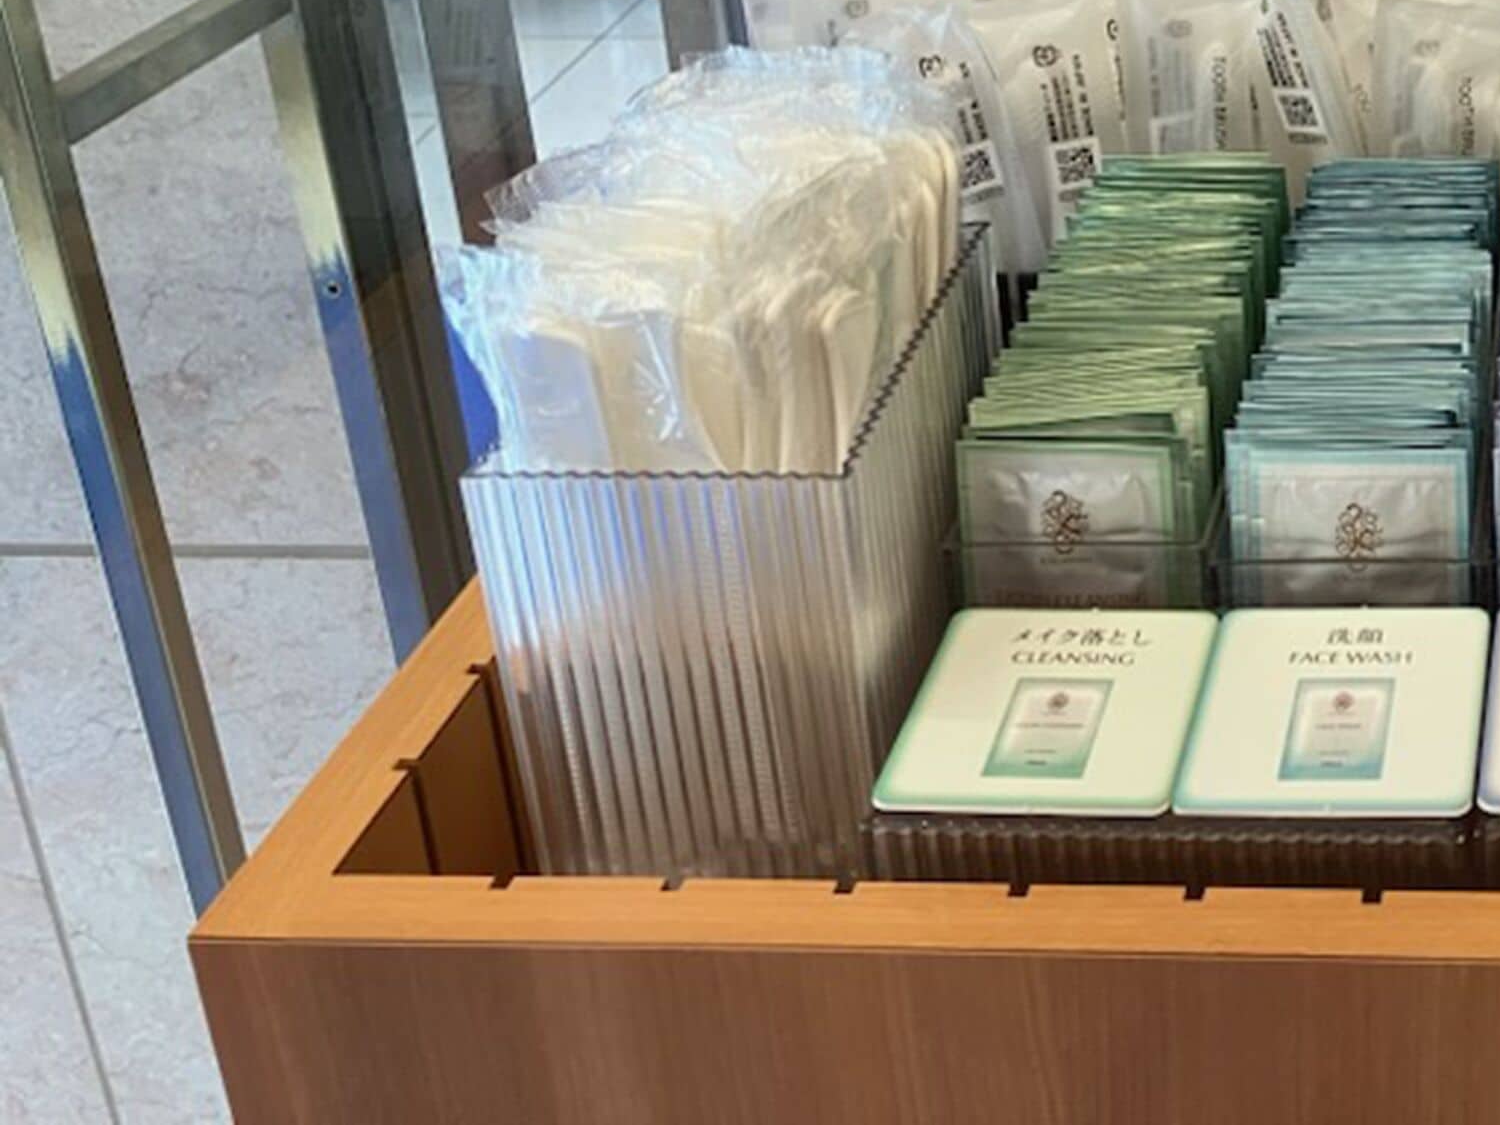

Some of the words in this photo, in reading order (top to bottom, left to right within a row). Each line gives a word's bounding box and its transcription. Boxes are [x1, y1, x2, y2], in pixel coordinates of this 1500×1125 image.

[1010, 650, 1136, 666] CLEANSING
[1288, 650, 1338, 665] FACE
[1346, 650, 1415, 665] WASH
